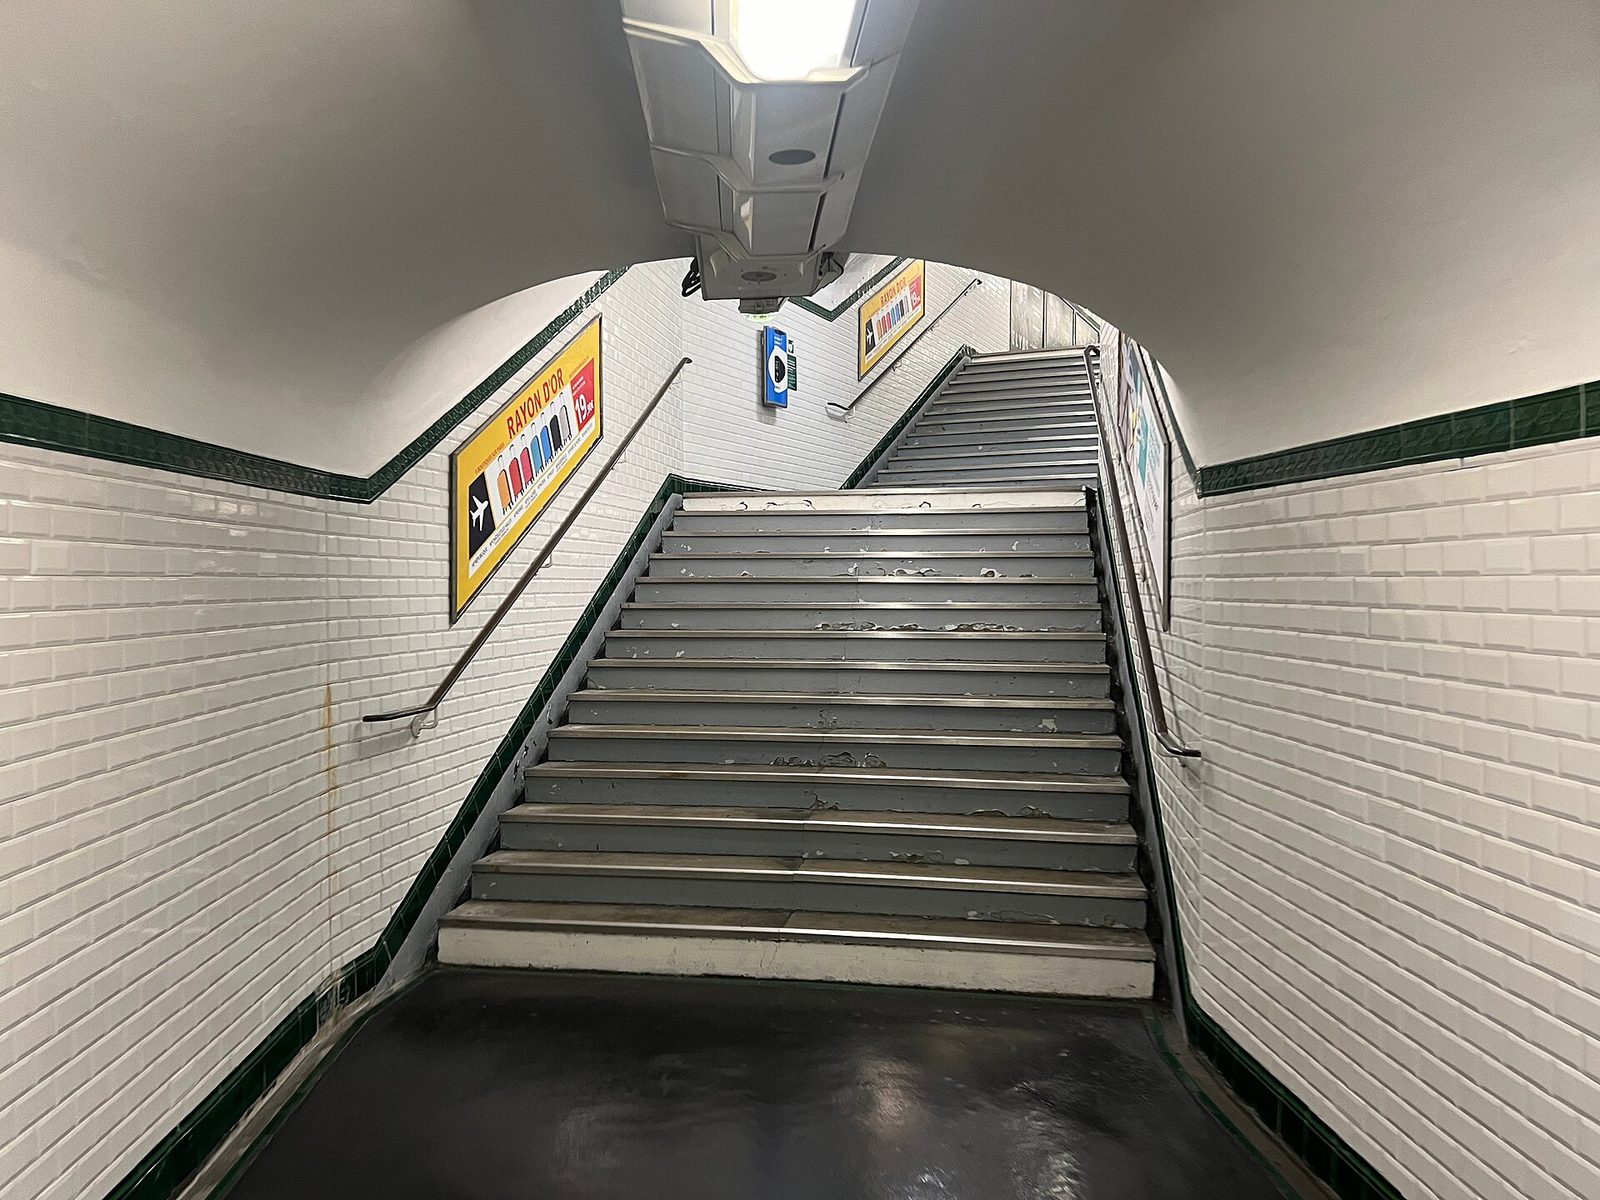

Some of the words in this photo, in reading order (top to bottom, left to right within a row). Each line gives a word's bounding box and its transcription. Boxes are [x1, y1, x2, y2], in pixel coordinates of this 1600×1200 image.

[880, 287, 896, 306] RAYON
[506, 389, 542, 439] RAYON
[542, 367, 564, 403] D'OR
